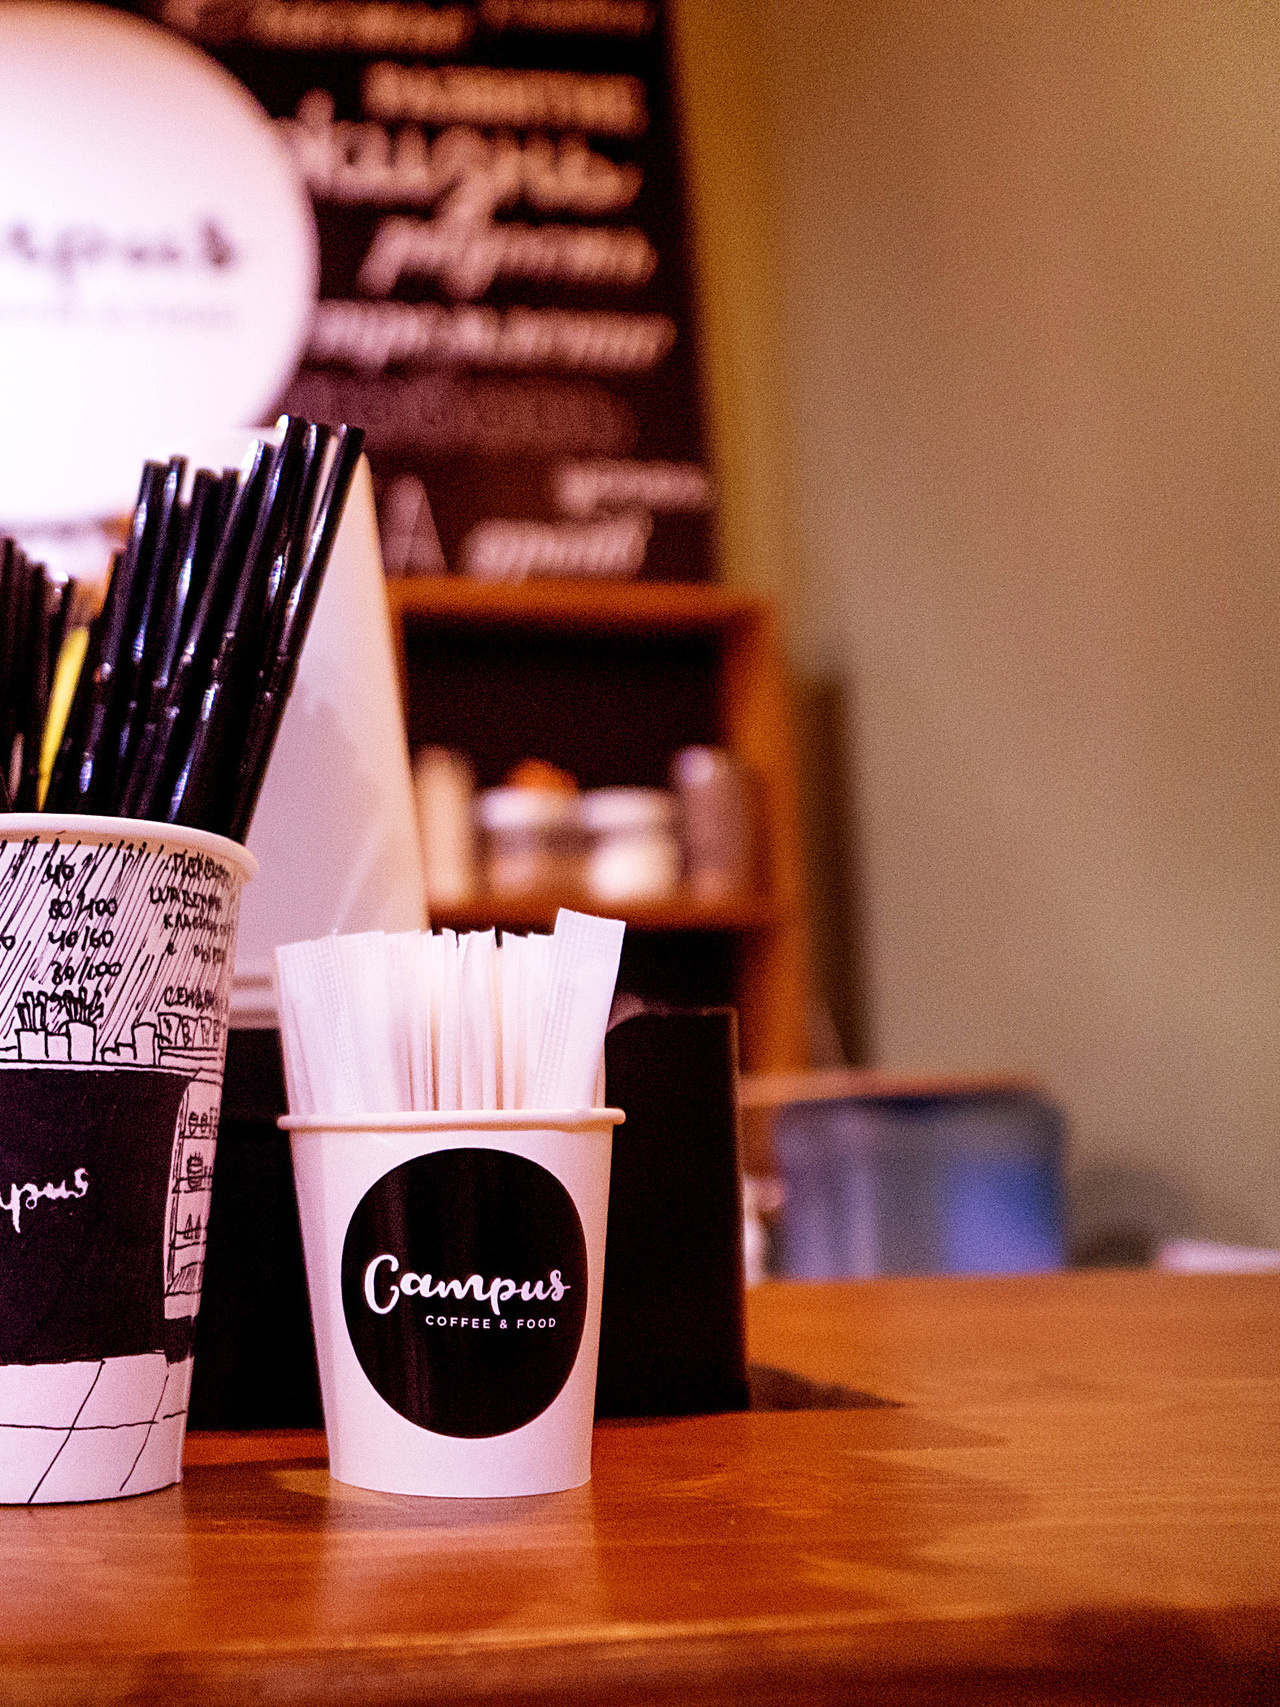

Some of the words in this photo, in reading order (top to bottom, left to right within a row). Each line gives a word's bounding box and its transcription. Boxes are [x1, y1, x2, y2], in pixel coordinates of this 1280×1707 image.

[48, 925, 114, 952] 40/60
[364, 1254, 571, 1315] Campus
[425, 1315, 491, 1329] COFFEE
[499, 1318, 508, 1330] &
[517, 1317, 557, 1330] FOOD
